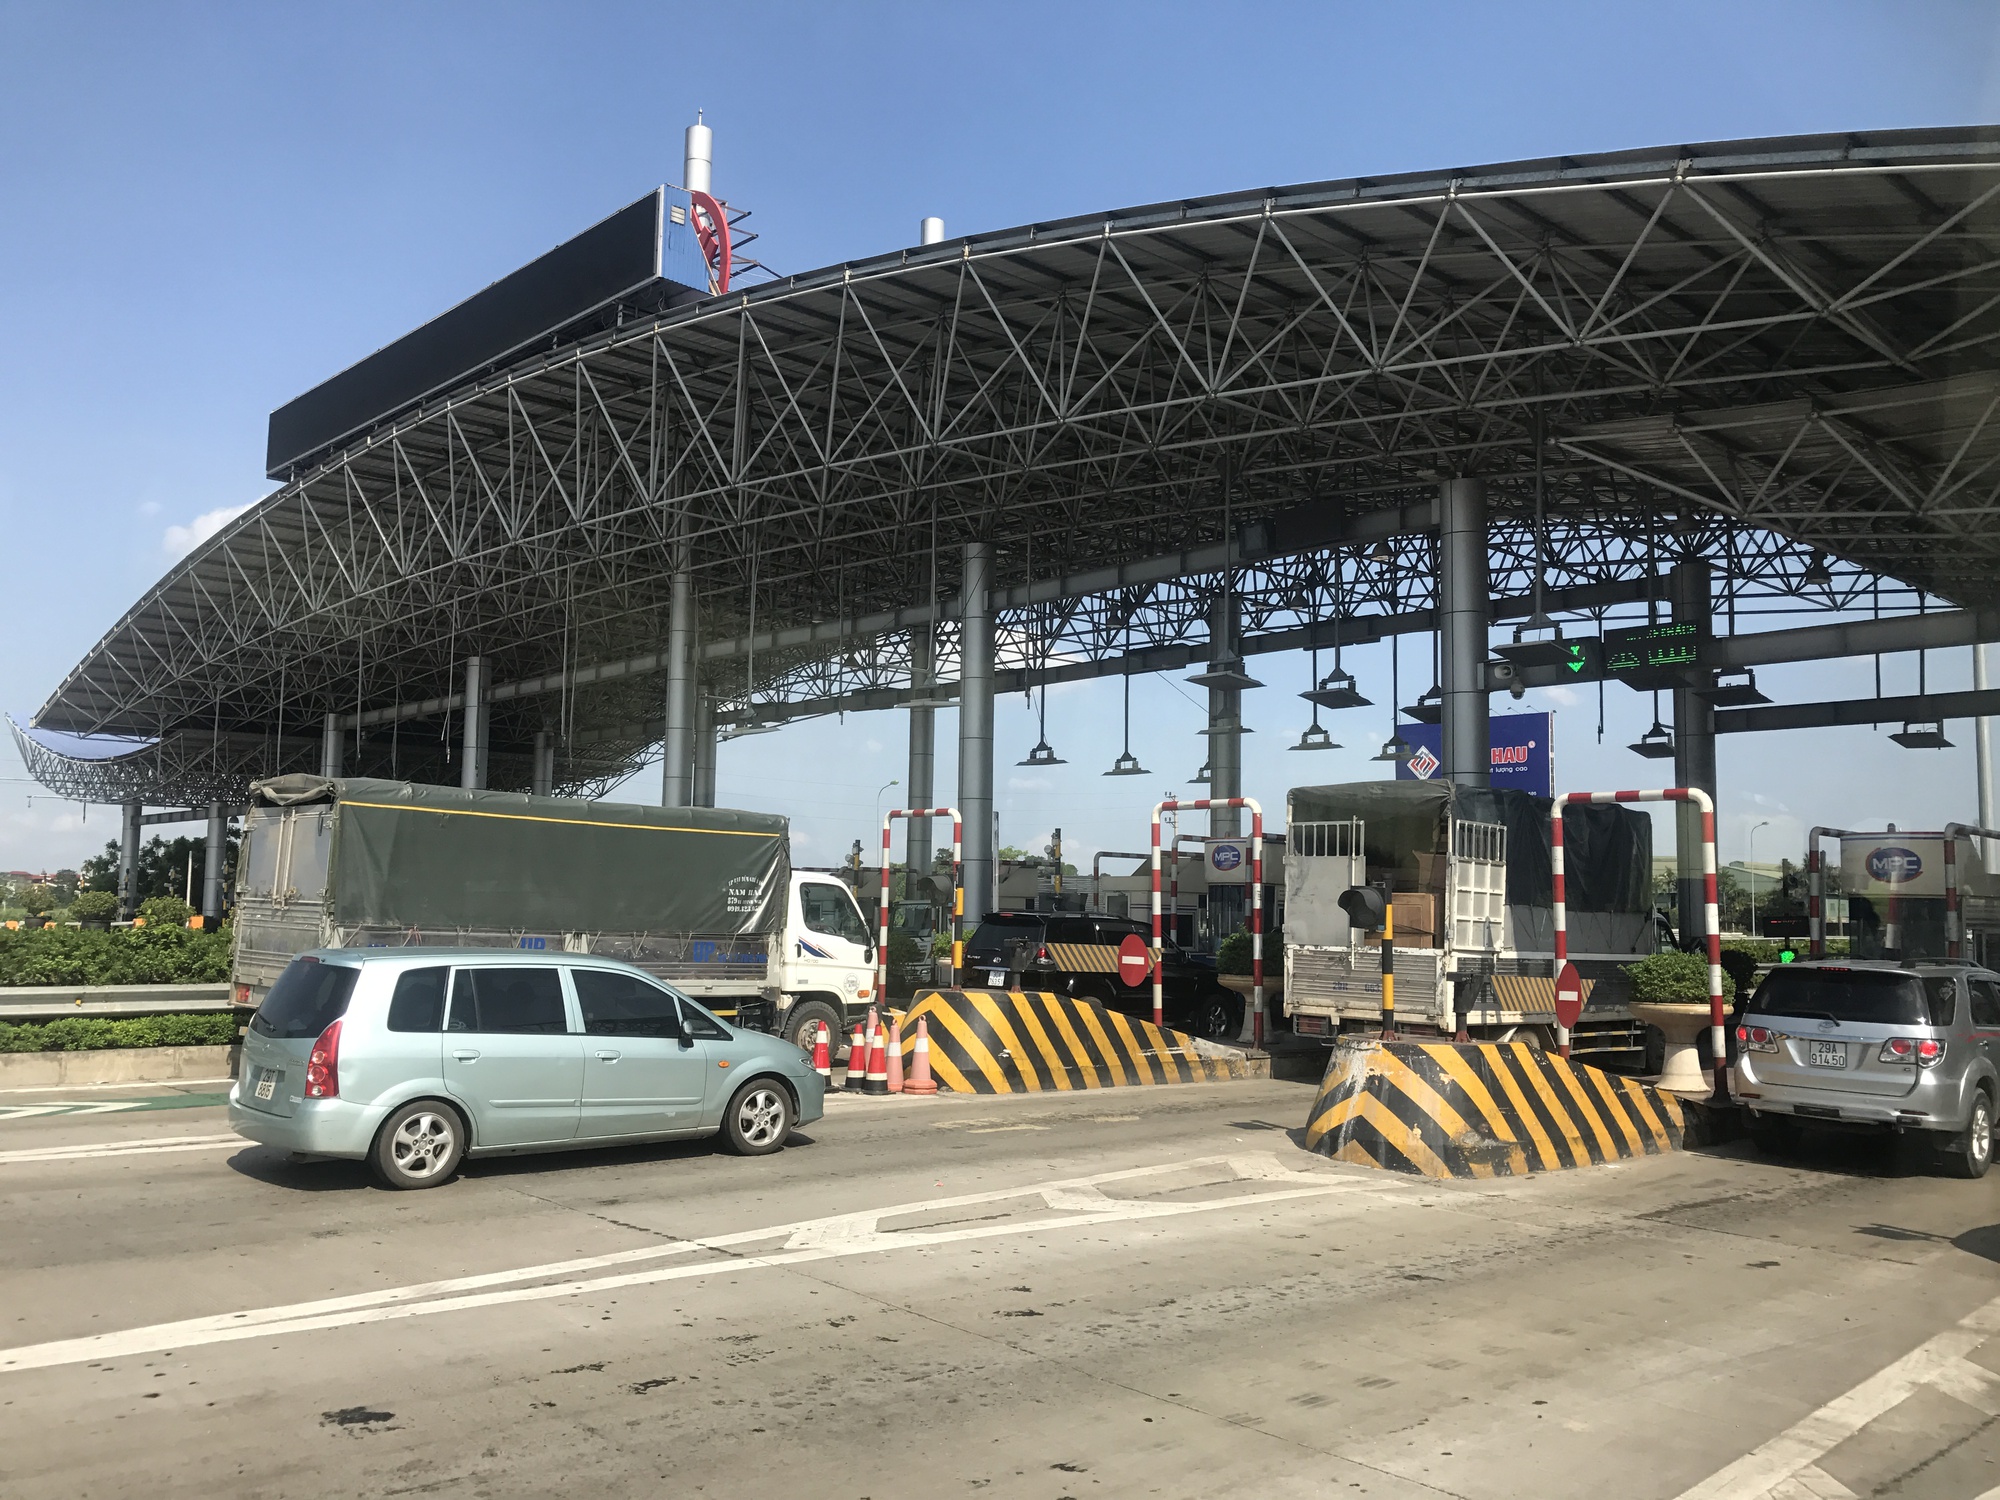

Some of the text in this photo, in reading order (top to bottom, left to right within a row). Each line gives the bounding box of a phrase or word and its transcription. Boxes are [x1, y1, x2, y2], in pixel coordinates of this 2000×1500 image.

[1491, 746, 1528, 764] HAU
[1214, 851, 1239, 862] MPC
[1872, 857, 1918, 870] MPC
[693, 941, 716, 963] UP
[1818, 1042, 1838, 1054] 29A
[1811, 1053, 1845, 1067] 914.50
